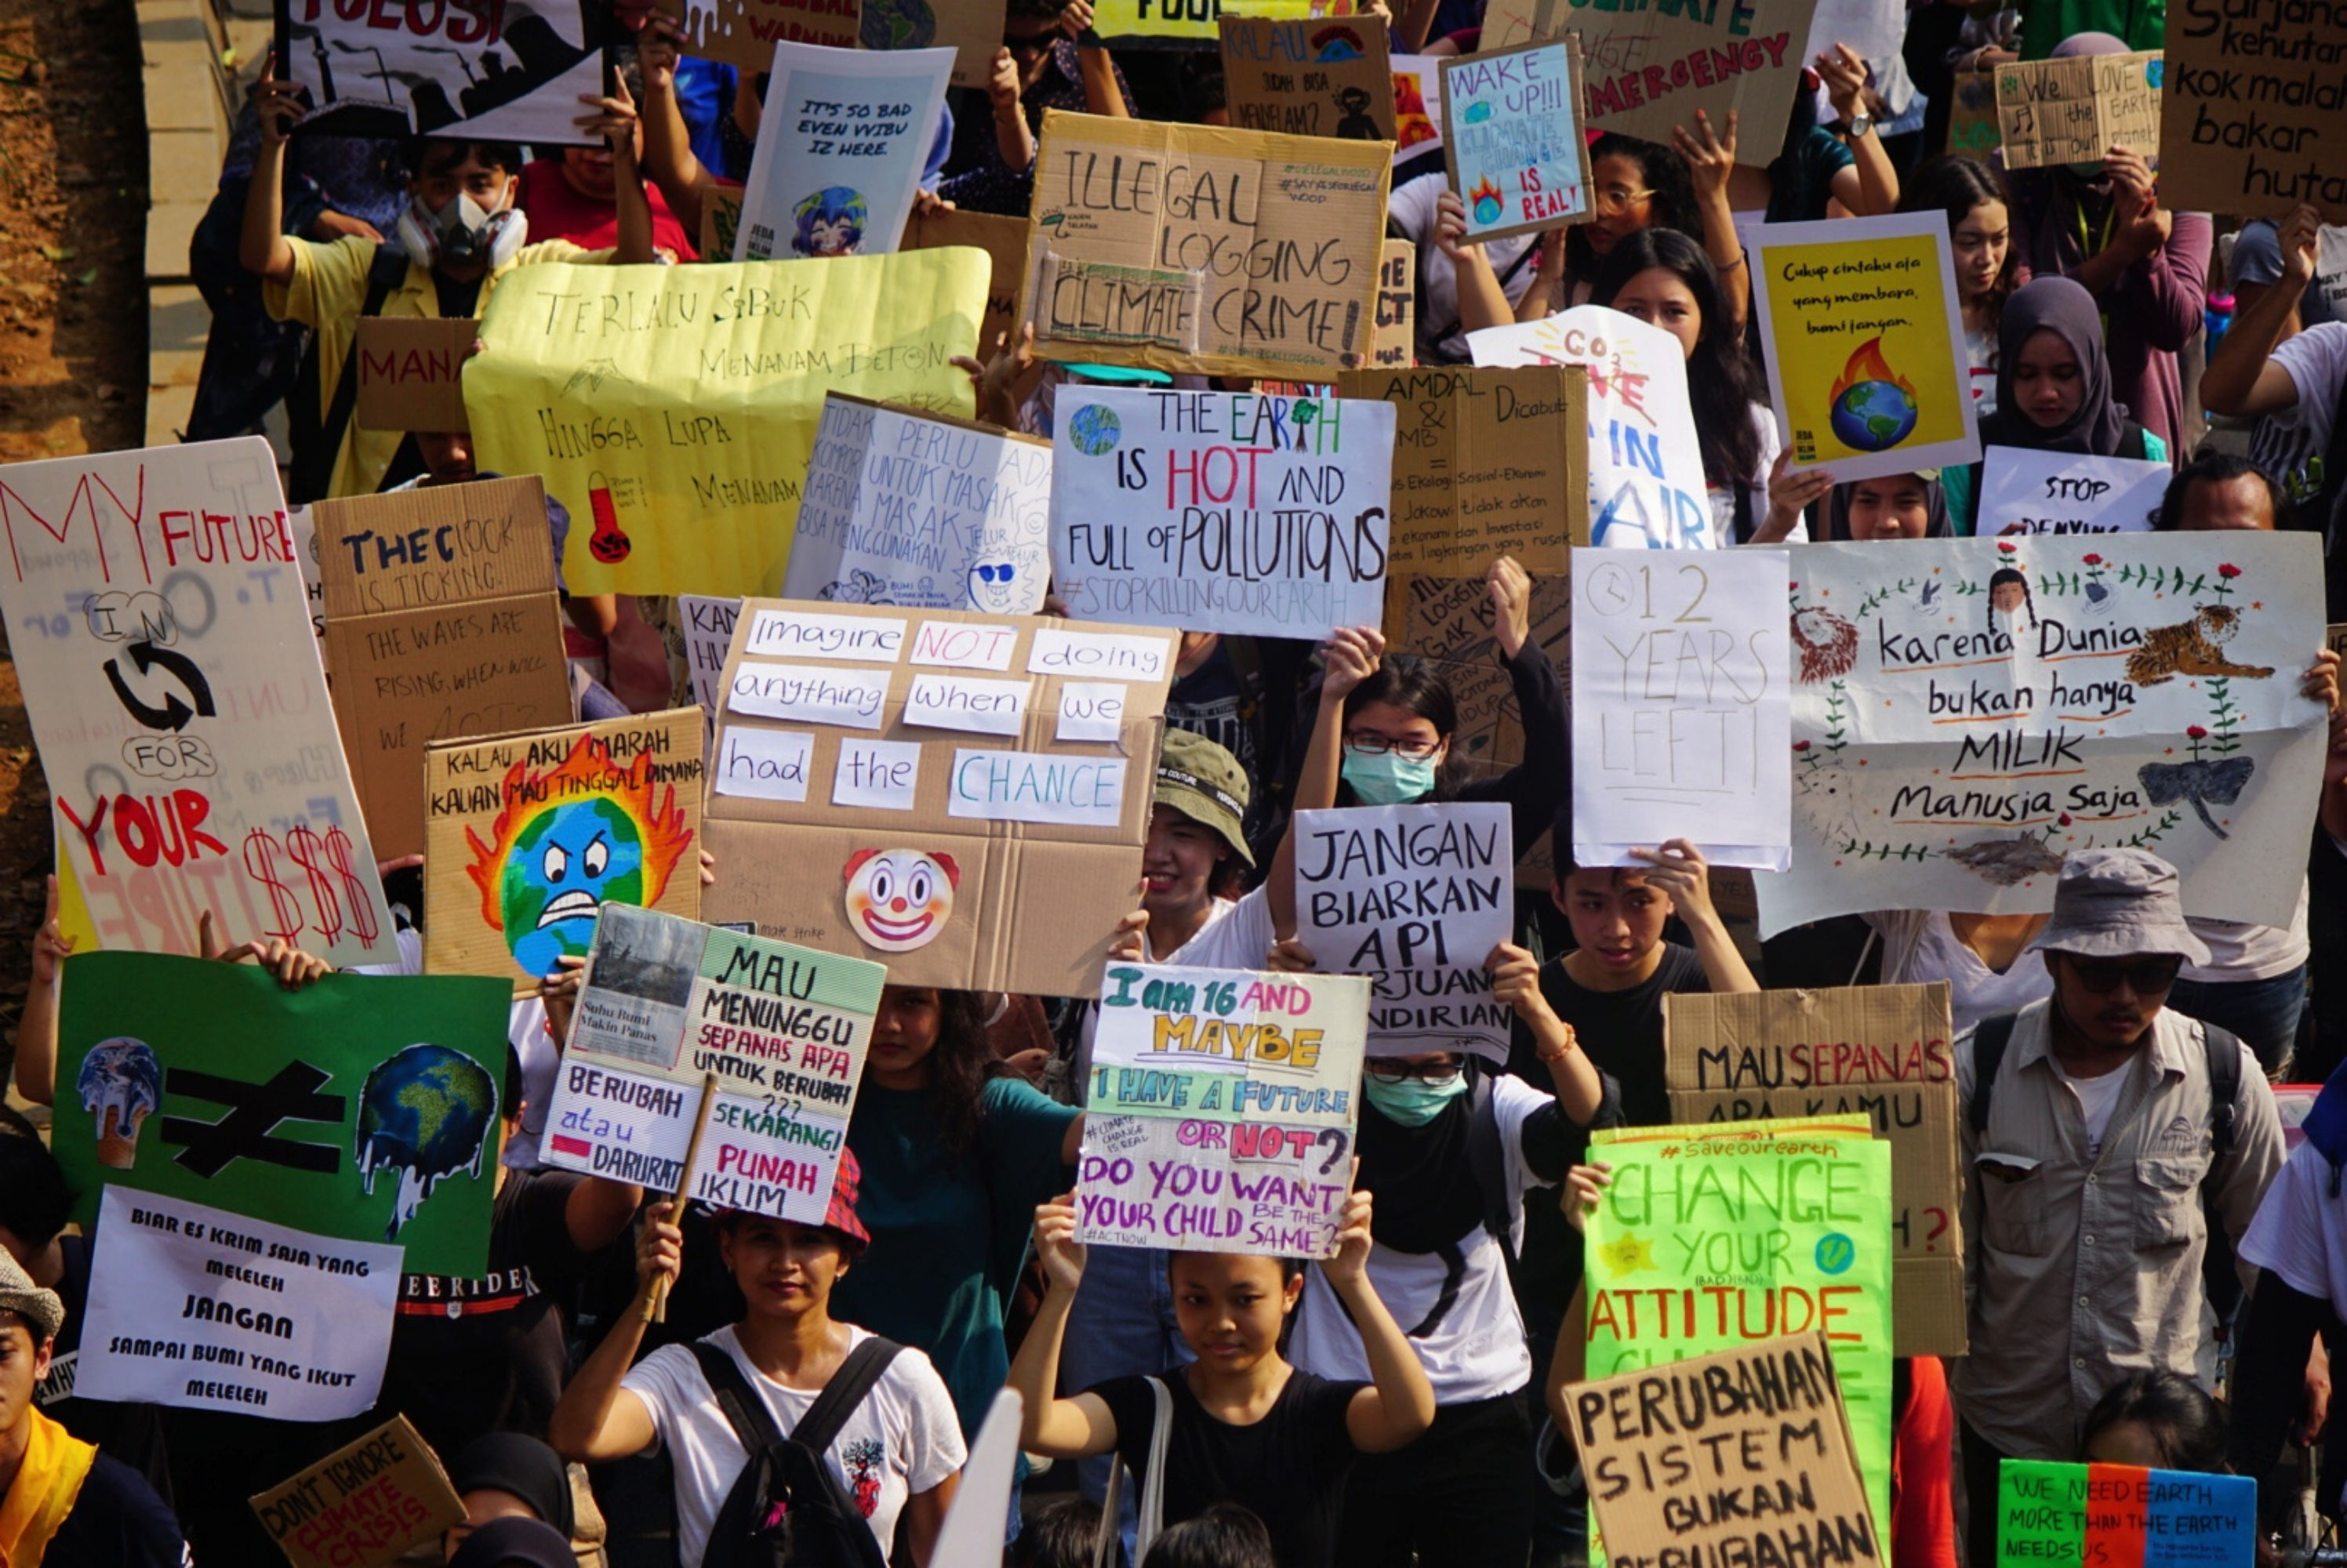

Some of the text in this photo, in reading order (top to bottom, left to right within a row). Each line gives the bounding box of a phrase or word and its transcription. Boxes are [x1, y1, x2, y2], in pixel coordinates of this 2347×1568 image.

[1223, 22, 1307, 63] KALAU
[1303, 72, 1328, 92] BISA
[1448, 52, 1541, 99] WAKE
[1506, 77, 1562, 113] UP!!!
[2021, 63, 2136, 101] We LOVE
[801, 100, 911, 118] IT'S SO BAD
[2068, 94, 2162, 123] the EARTH
[2192, 102, 2320, 153] bakar
[838, 142, 887, 156] HERE.
[1064, 150, 1257, 227] ILLEGAL
[1289, 193, 1327, 203] WOOD
[1520, 167, 1542, 193] IS
[1161, 224, 1352, 285] LOGGING
[1783, 256, 1920, 281] Cukup cintaku aja
[1052, 274, 1198, 337] CLIMATE
[1793, 292, 1830, 310] yang
[1807, 316, 1913, 335] bumi jangan.
[1384, 372, 1486, 401] AMDAL
[1495, 384, 1568, 423] Dicabut
[1117, 445, 1346, 510] IS HOT AND
[2044, 476, 2111, 503] STOP
[0, 464, 296, 585] MY FUTURE
[798, 503, 1008, 573] BISA MENGGUNAKAN TELUR
[1069, 506, 1386, 583] FULL OF POLLUTIONS
[1421, 532, 1572, 564] lingkungan yang rusak
[1455, 528, 1477, 538] dan
[366, 611, 528, 662] THE WAVES ARE
[754, 616, 1160, 674] Imagine NOT doing
[1878, 616, 2142, 668] karena Dunia
[452, 661, 504, 691] WHEN
[509, 656, 547, 671] WILL
[1602, 628, 1770, 705] YEARS
[733, 673, 884, 715] anything
[1063, 695, 1122, 720] we
[1927, 670, 2137, 718] bukan hanya
[133, 739, 211, 771] FOR
[446, 728, 670, 778] KALAU AKU MARAH
[728, 738, 1119, 809] had the CHANCE
[1953, 725, 2086, 775] MILIK
[431, 758, 705, 817] KALIAN MAU TINGGAL DIMANA
[1889, 783, 2142, 822] Manusia Saja
[1299, 820, 1498, 882] JANGAN
[1311, 875, 1502, 928] BIARKAN
[1349, 920, 1448, 969] API
[715, 946, 817, 1000] MAU
[1103, 968, 1312, 1017] I am 16 AND
[581, 1014, 657, 1042] Makin Panas
[584, 1001, 650, 1026] Suhu Bumi
[702, 988, 853, 1047] MENUNGGU
[697, 1023, 791, 1063] SEPANAS
[800, 1047, 851, 1080] APA
[1153, 1014, 1325, 1068] MAYBE
[694, 1050, 852, 1108] UNTUK BERUBAH
[1697, 1039, 1952, 1092] MAU SEPANAS
[569, 1066, 684, 1119] BERUBAH
[1098, 1068, 1350, 1114] I HAVE A FUTURE
[560, 1108, 634, 1142] atau
[1101, 1124, 1145, 1145] CHANGE
[1106, 1133, 1148, 1153] IS REAL
[1176, 1119, 1227, 1150] OR
[717, 1143, 819, 1196] PUNAH
[1660, 1139, 1838, 1159] #saveourearth
[698, 1172, 787, 1216] IKLIM
[1083, 1156, 1345, 1216] DO YOU WANT
[1609, 1158, 1863, 1227] CHANGE
[1081, 1194, 1243, 1238] YOUR CHILD
[1084, 1229, 1147, 1246] #ACTNOW
[1247, 1221, 1339, 1254] SAME?
[1253, 1203, 1324, 1225] BE THE
[130, 1207, 370, 1277] BIAR ES KRIM SAJA YANG
[1672, 1230, 1794, 1277] YOUR
[205, 1259, 285, 1293] MELELEH
[182, 1294, 294, 1340] JANGAN
[1587, 1285, 1863, 1342] ATTITUDE
[108, 1337, 356, 1387] SAMPAI BUMI YANG IKUT
[186, 1379, 268, 1406] MELELEH
[1578, 1341, 1836, 1446] PERUBAHAN
[1595, 1418, 1826, 1502] SISTEM
[1663, 1471, 1816, 1535] BUKAN
[2014, 1474, 2213, 1505] WE NEED EARTH
[2009, 1507, 2238, 1535] MORE THAN THE EARTH
